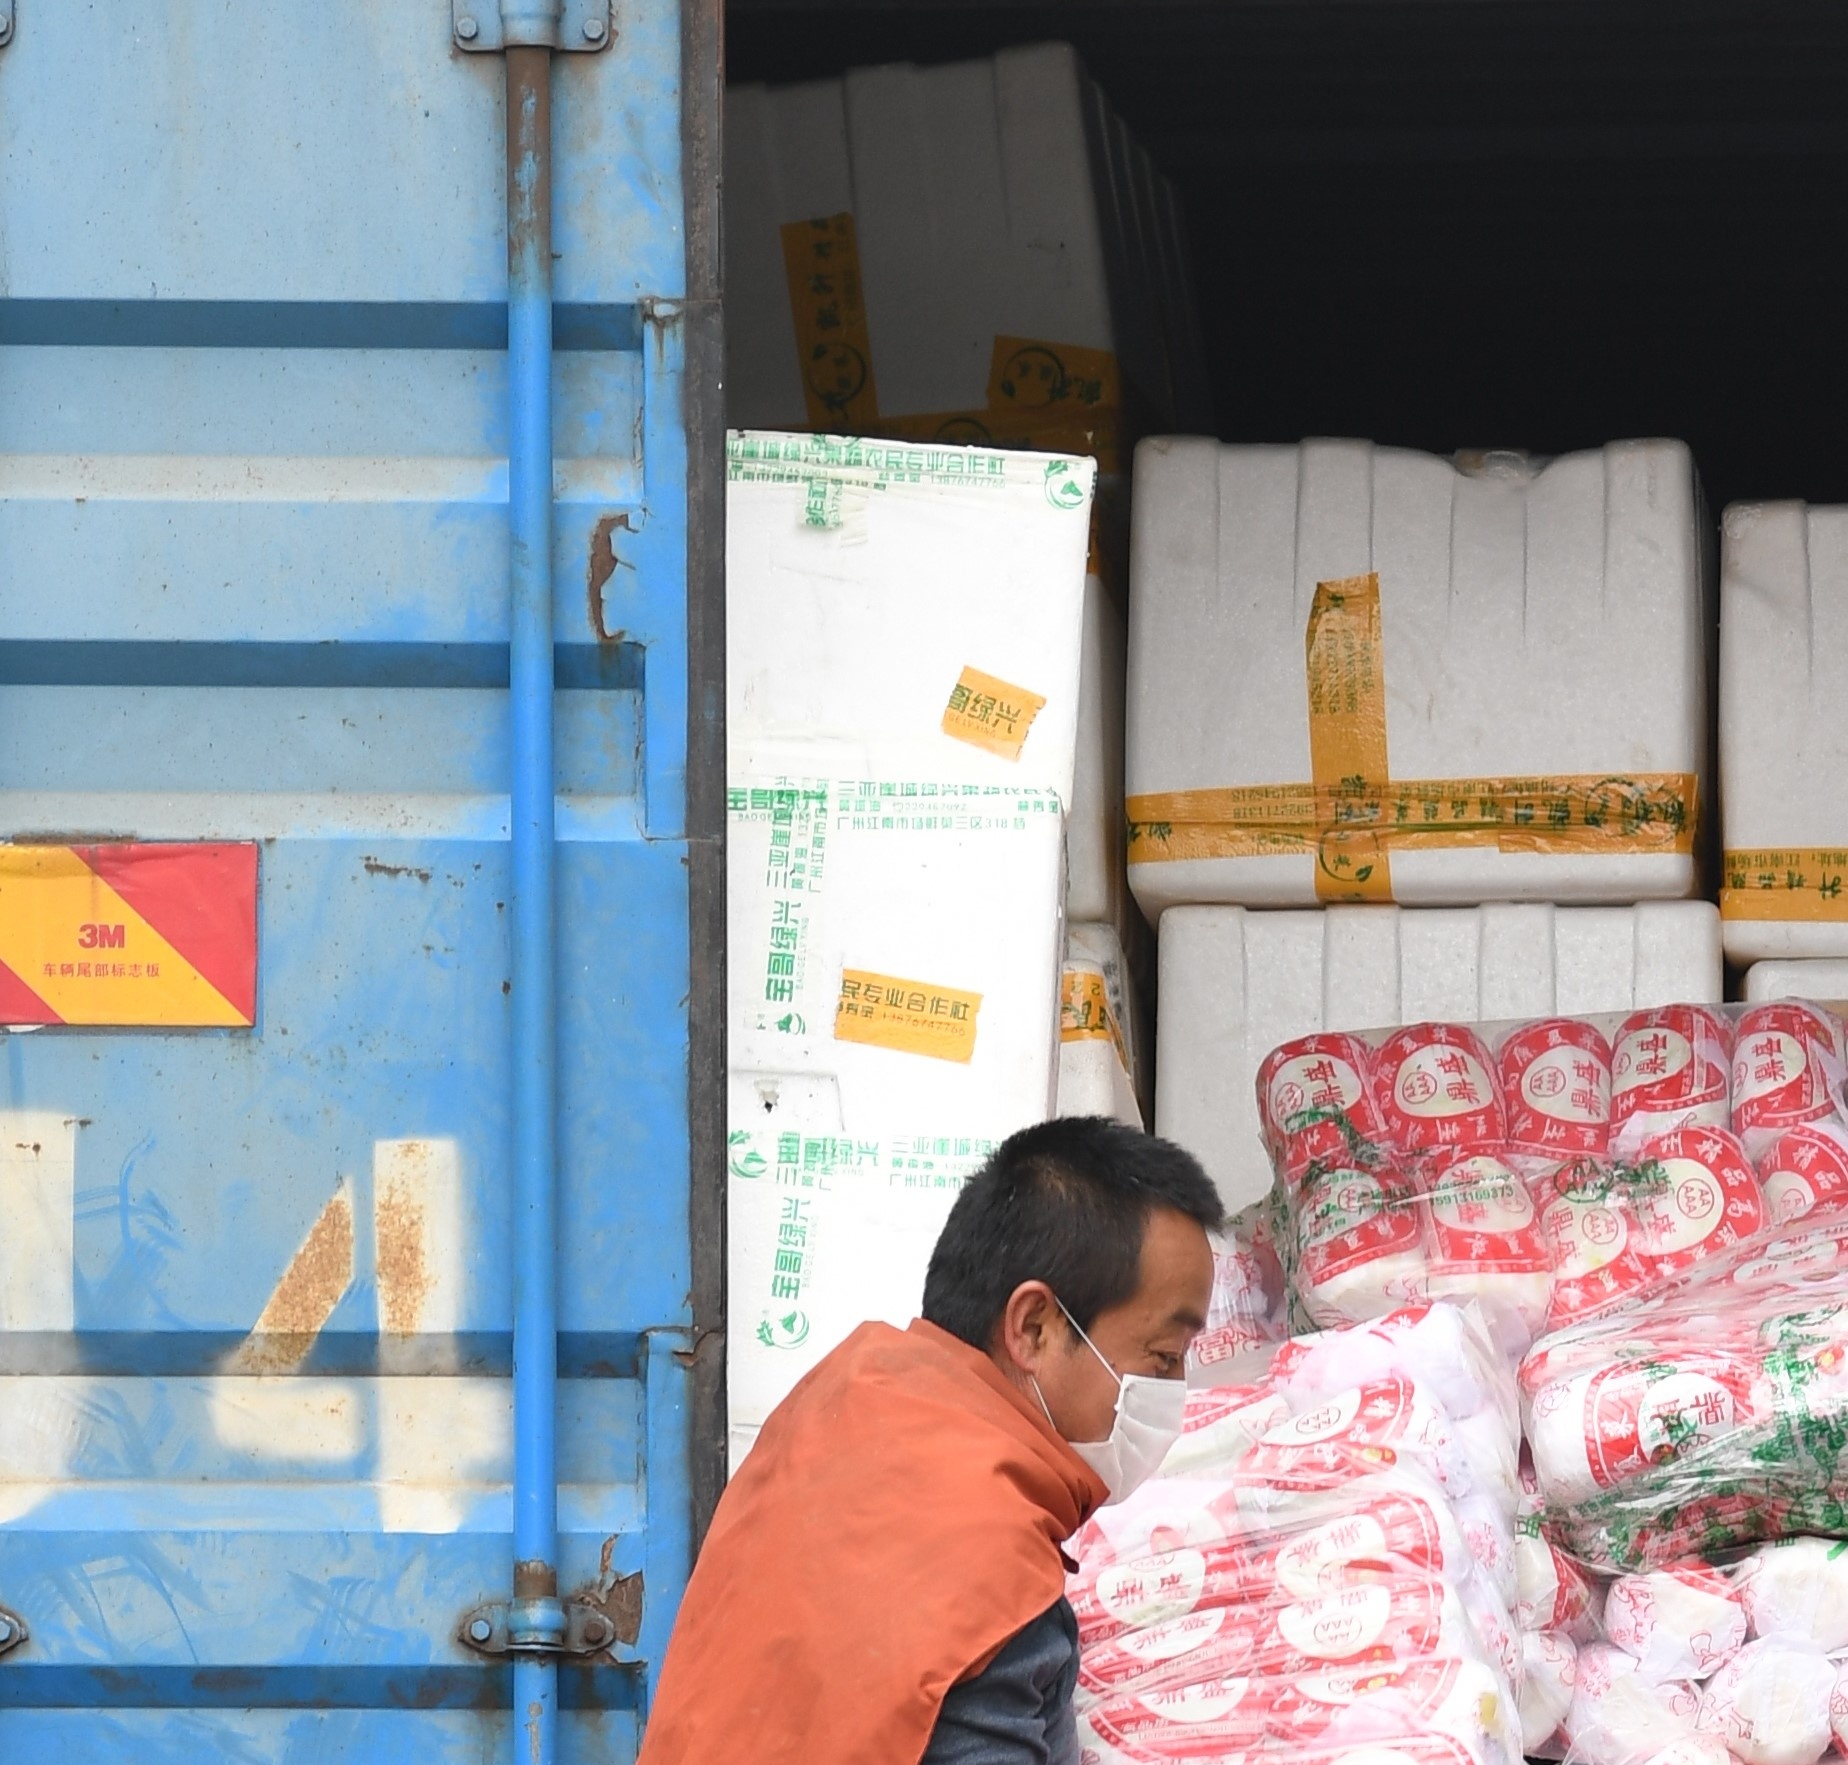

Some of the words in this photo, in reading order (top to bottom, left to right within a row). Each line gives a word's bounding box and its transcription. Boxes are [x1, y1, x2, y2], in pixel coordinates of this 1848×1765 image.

[78, 924, 125, 949] 3M
[43, 962, 160, 979] 车辆尾部标志板
[1636, 1034, 1668, 1076] 鼎盛
[1753, 1038, 1786, 1084] 鼎盛
[1438, 1053, 1481, 1105] 鼎盛
[1571, 1060, 1604, 1117] 鼎盛
[772, 1197, 811, 1300] 宝哥绿兴
